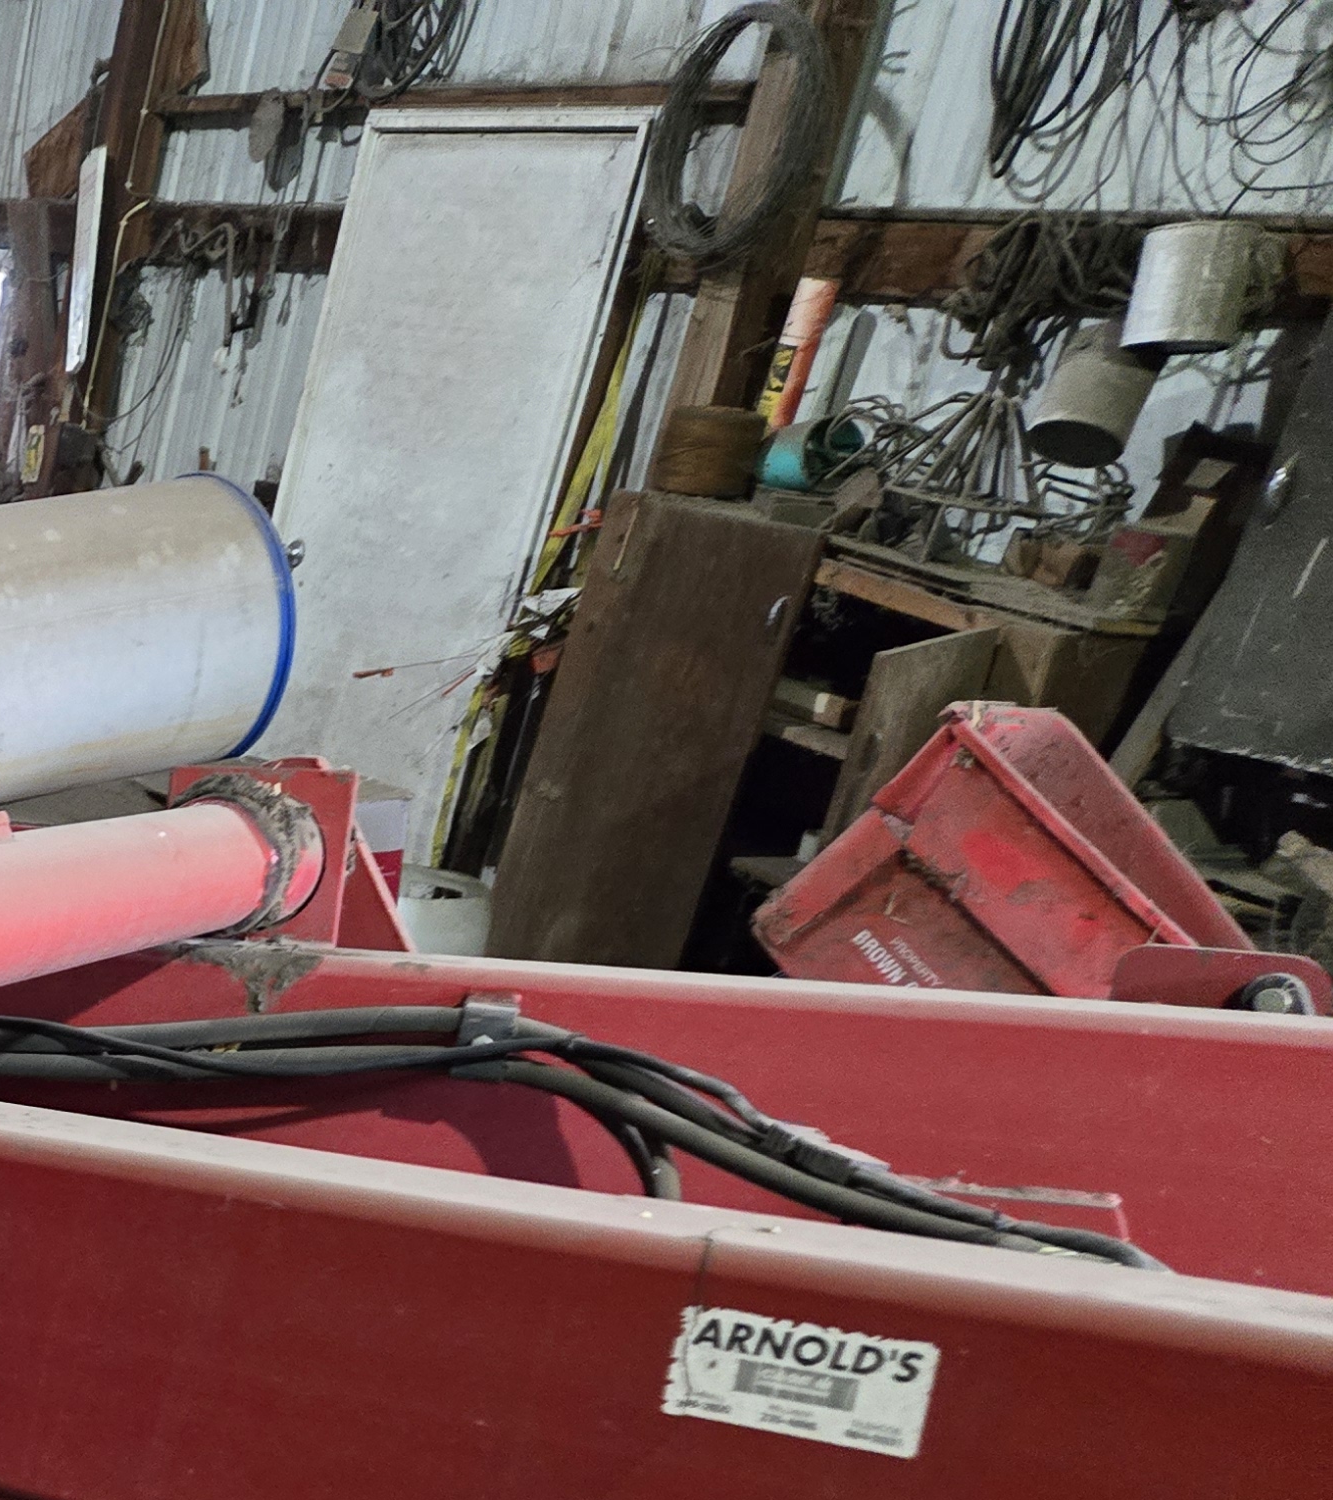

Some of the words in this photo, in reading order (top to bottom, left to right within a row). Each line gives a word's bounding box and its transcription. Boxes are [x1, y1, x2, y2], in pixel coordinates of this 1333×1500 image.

[851, 929, 907, 984] BROWN
[889, 935, 944, 986] PROPERTY
[693, 1318, 925, 1383] ARNOLD'S
